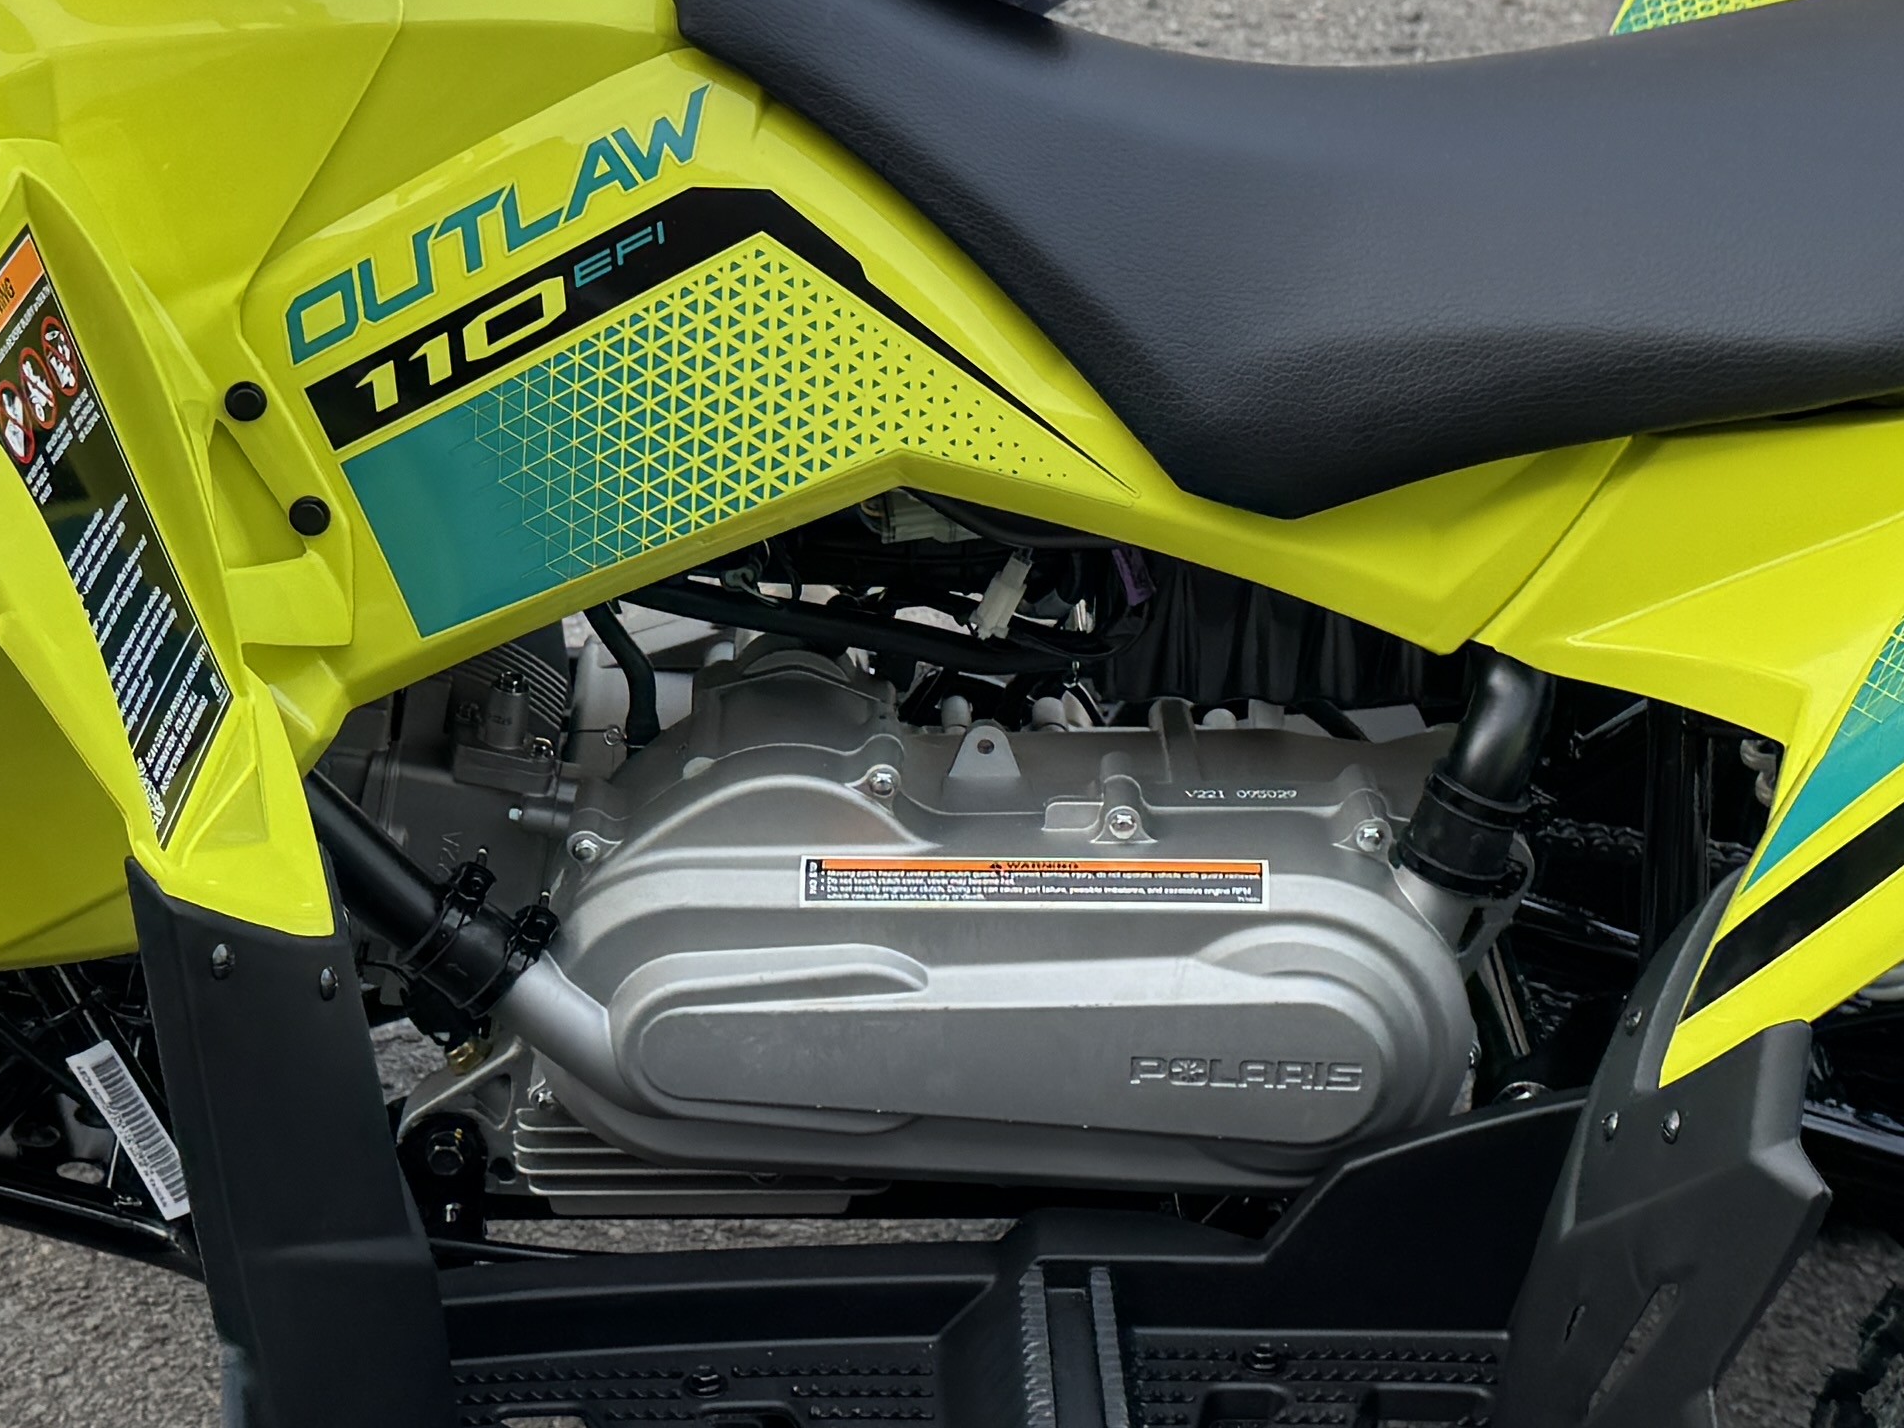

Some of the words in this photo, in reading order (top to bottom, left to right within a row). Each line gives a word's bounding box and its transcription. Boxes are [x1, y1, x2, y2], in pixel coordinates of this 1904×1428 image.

[285, 83, 712, 368] OUTLAW
[355, 276, 567, 413] 110
[574, 221, 665, 288] EFI
[1130, 1056, 1363, 1092] POLARIS
